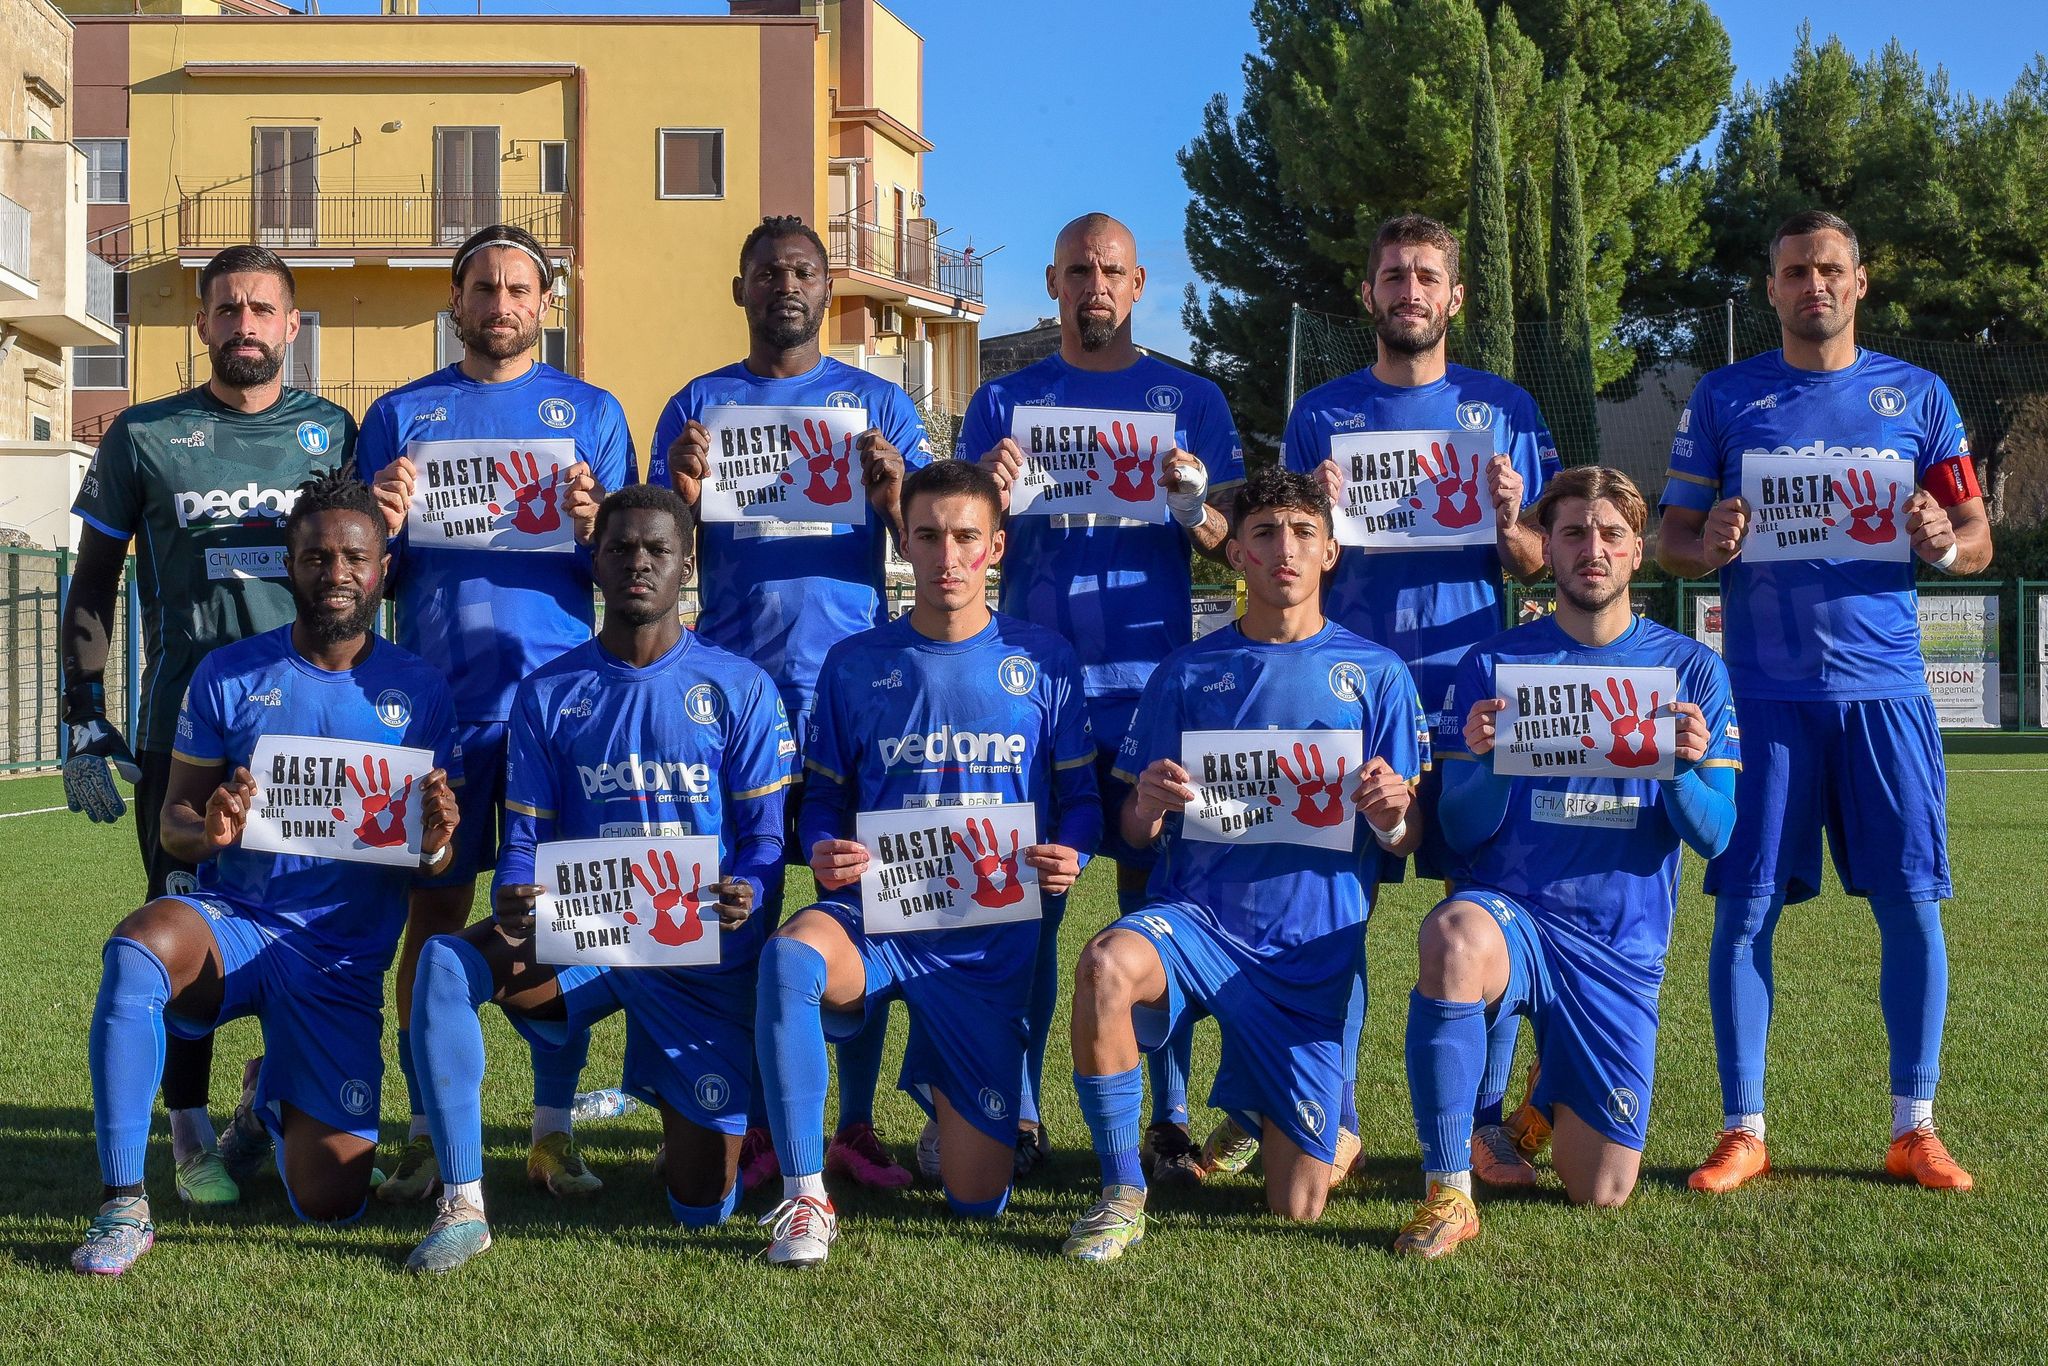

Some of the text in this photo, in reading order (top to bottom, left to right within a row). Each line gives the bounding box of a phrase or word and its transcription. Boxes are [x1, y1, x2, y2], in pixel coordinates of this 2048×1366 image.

[1350, 421, 1365, 429] LAB
[170, 437, 193, 445] OVER
[721, 424, 792, 457] BASTA
[1031, 426, 1099, 453] BASTA
[427, 456, 499, 488] BASTA
[719, 453, 789, 480] VIOLENZA
[1027, 453, 1096, 475] VIOLENZA
[1351, 449, 1420, 482] BASTA
[715, 480, 737, 493] SULLE
[1024, 474, 1044, 487] SULLE
[1762, 474, 1834, 505] BASTA
[425, 484, 497, 512] VIOLENZA
[736, 485, 786, 510] DONNE
[1044, 481, 1092, 502] DONNE
[1348, 478, 1417, 506] VIOLENZA
[422, 511, 445, 523] SULLE
[1345, 505, 1367, 518] SULLE
[1759, 504, 1831, 524] VIOLENZA
[443, 516, 494, 538] DONNE
[1365, 511, 1416, 535] DONNE
[1756, 522, 1779, 534] SULLE
[1777, 527, 1828, 550] DONNE
[209, 551, 269, 566] CHIARITO
[1919, 604, 1995, 621] archese
[872, 677, 892, 688] OVER
[887, 680, 904, 689] LAB
[1010, 671, 1024, 687] U
[1203, 681, 1224, 693] OVER
[1219, 681, 1236, 693] LAB
[249, 694, 270, 703] OVER
[1517, 683, 1593, 717] BASTA
[1930, 686, 1974, 695] anagement
[264, 698, 281, 706] LAB
[387, 705, 400, 719] U
[561, 705, 582, 716] OVER
[698, 699, 711, 715] U
[577, 708, 593, 717] LAB
[1941, 716, 1974, 724] Bisceglie
[1514, 715, 1591, 742] VIOLENZA
[878, 725, 1026, 775] pedone
[1510, 741, 1534, 753] SULLE
[969, 762, 1023, 774] ferramenta
[1203, 750, 1280, 783] BASTA
[1532, 749, 1588, 768] DONNE
[273, 755, 347, 788] BASTA
[577, 753, 709, 800] pedone
[266, 788, 343, 808] VIOLENZA
[655, 791, 710, 804] ferramenta
[1200, 780, 1277, 807] VIOLENZA
[260, 808, 285, 820] SULLE
[1200, 804, 1224, 819] SULLE
[1534, 795, 1636, 815] CHIARITO RENT
[1222, 806, 1274, 834] DONNE
[281, 820, 336, 841] DONNE
[878, 826, 956, 864] BASTA
[556, 857, 635, 895] BASTA
[878, 856, 954, 891] VIOLENZA
[554, 890, 633, 920] VIOLENZA
[877, 888, 901, 903] SULLE
[900, 890, 955, 919] DONNE
[551, 920, 577, 932] SULLE
[575, 926, 630, 952] DONNE
